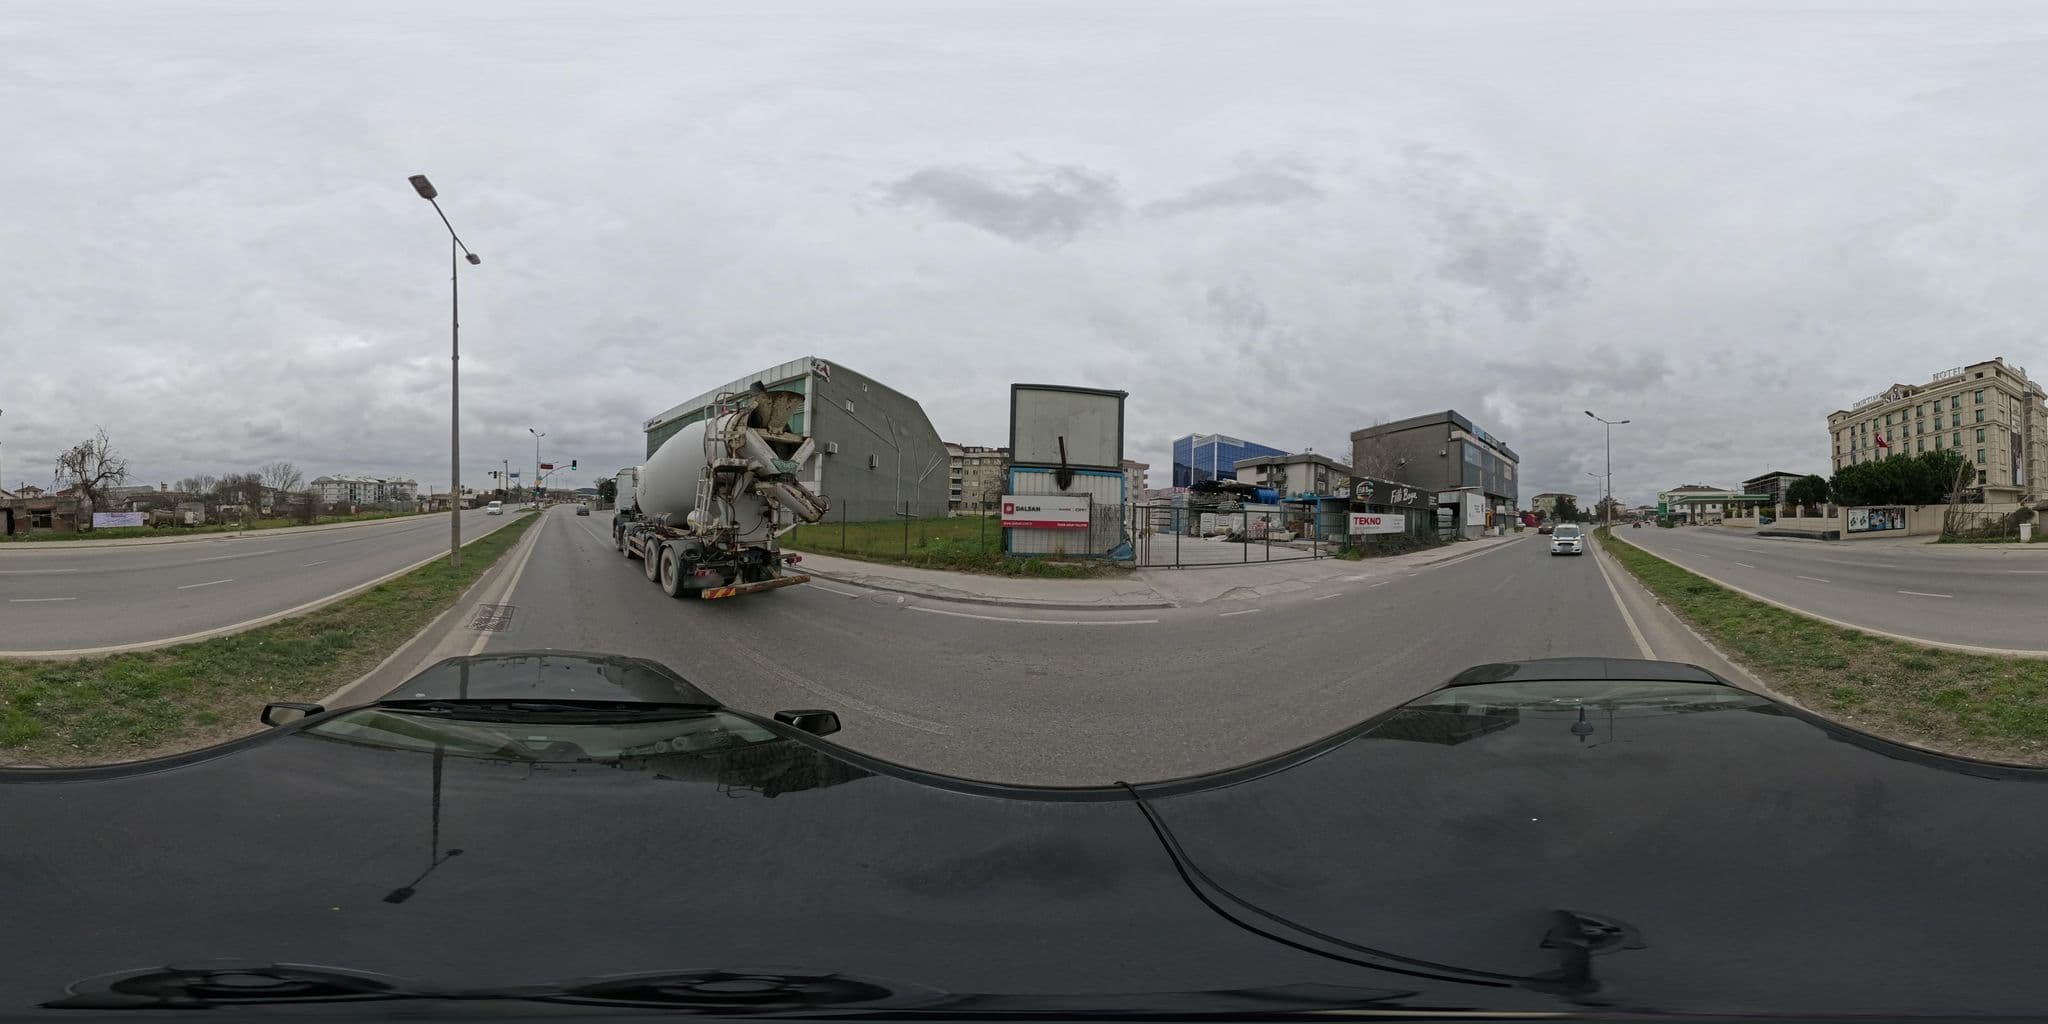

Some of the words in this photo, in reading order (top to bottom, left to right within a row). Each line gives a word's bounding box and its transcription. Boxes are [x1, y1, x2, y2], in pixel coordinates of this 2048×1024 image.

[1932, 367, 1965, 381] HOTEL
[1403, 488, 1418, 504] Boya
[1353, 516, 1382, 526] TEKNO
